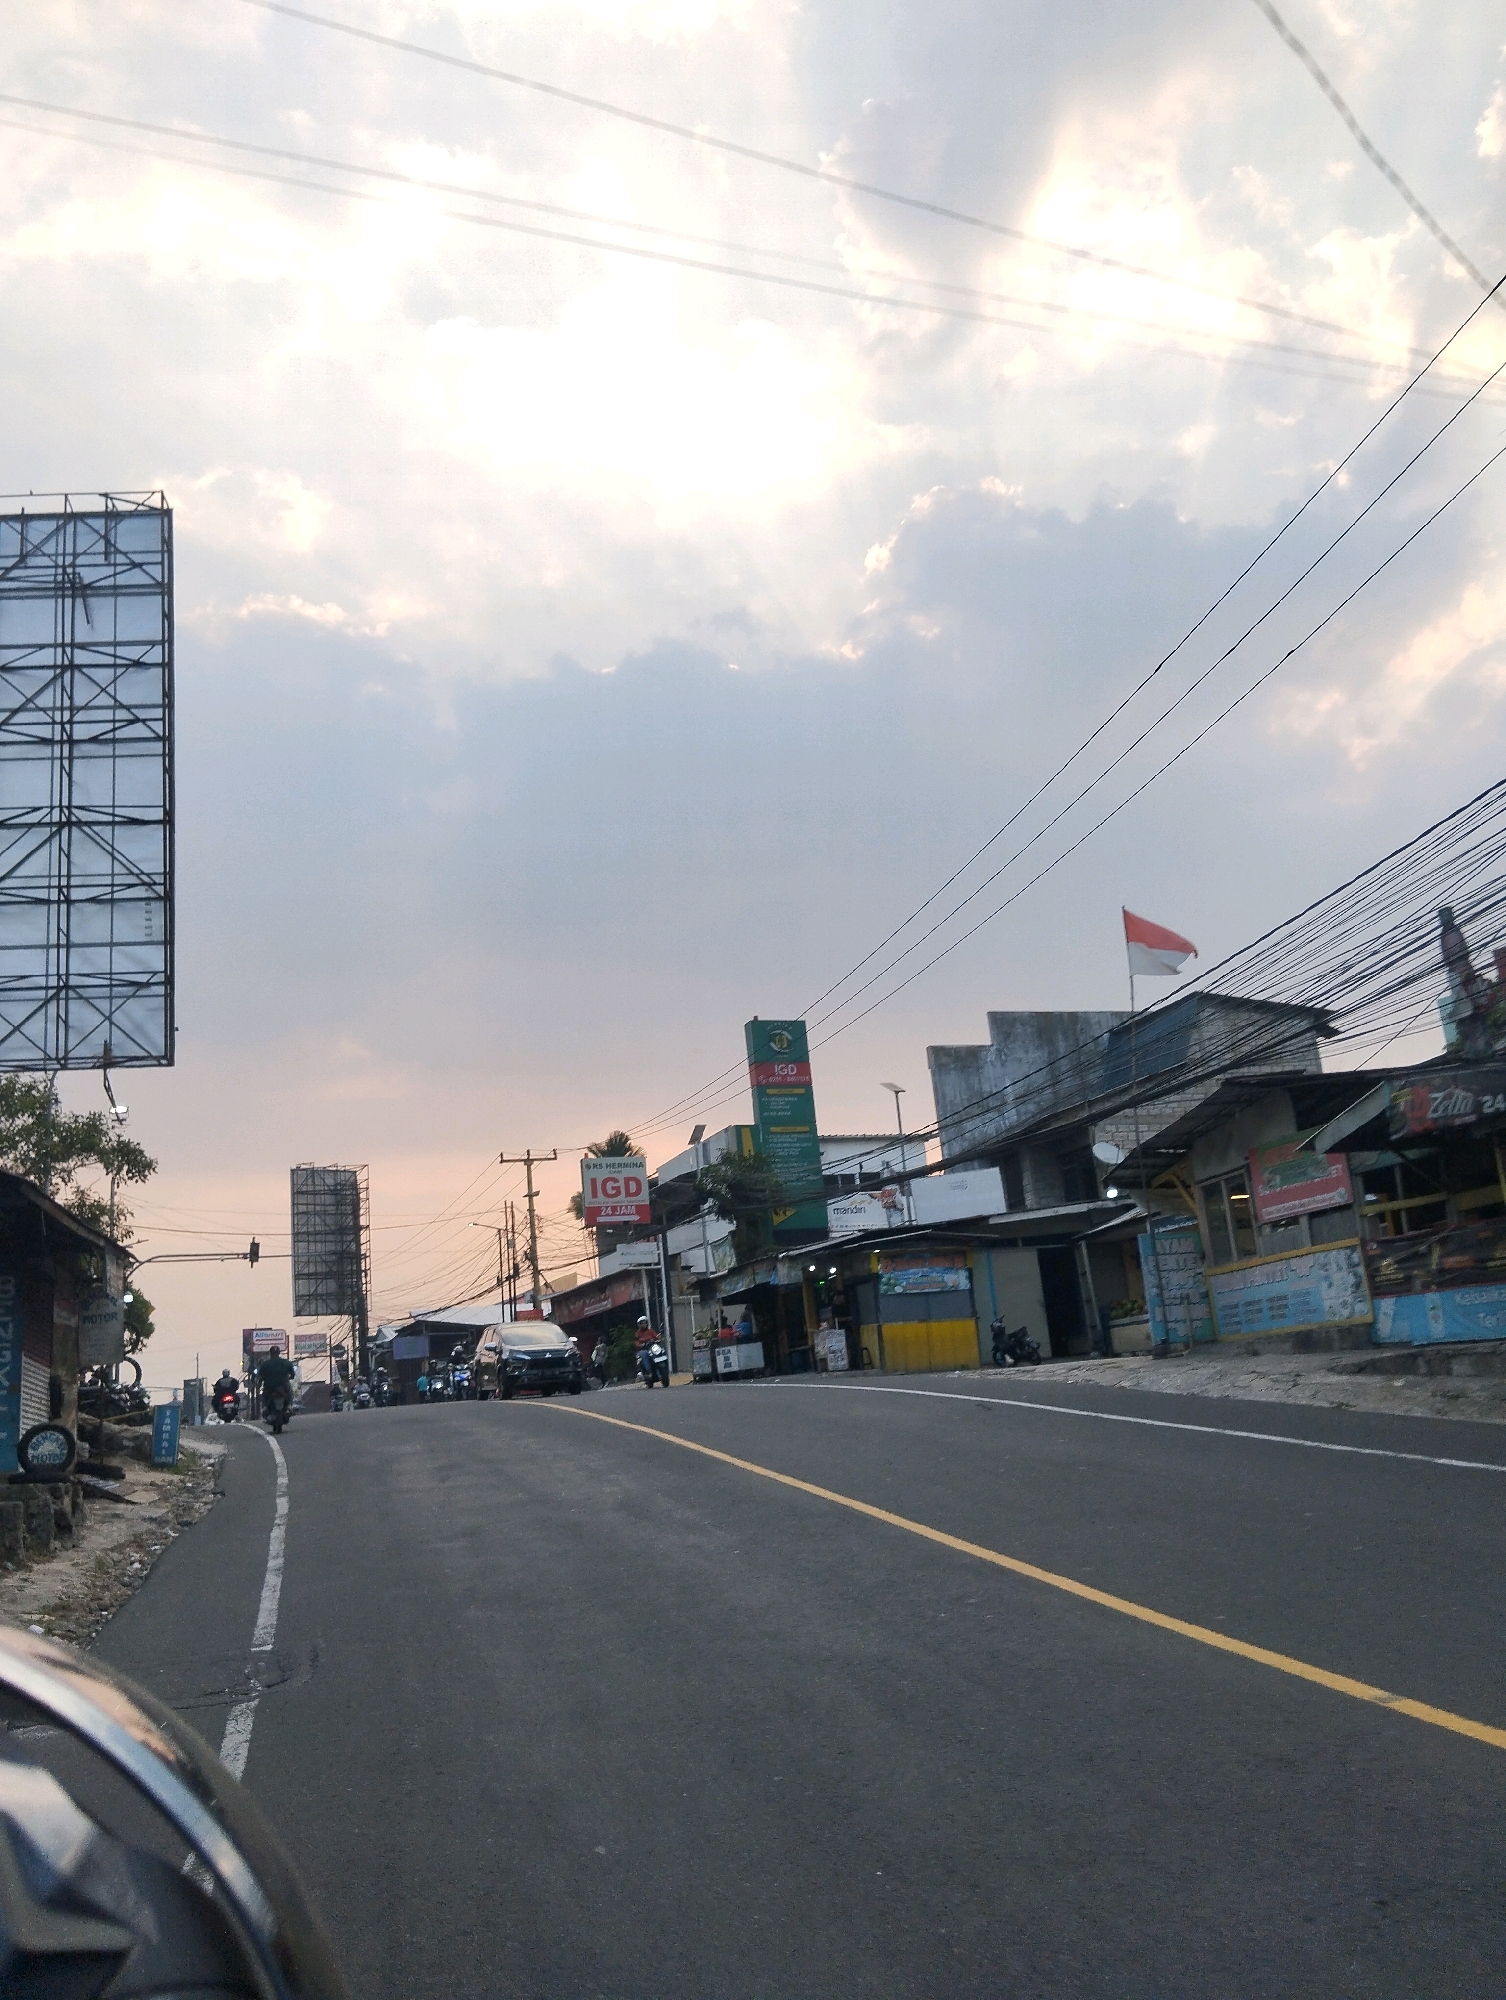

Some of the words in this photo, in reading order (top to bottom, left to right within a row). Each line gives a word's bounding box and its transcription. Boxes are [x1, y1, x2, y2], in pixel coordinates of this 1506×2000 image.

[774, 1063, 797, 1075] IGD
[605, 1162, 644, 1170] HERMINA
[590, 1176, 643, 1199] IGD
[601, 1206, 612, 1216] 24
[615, 1205, 636, 1215] JAM
